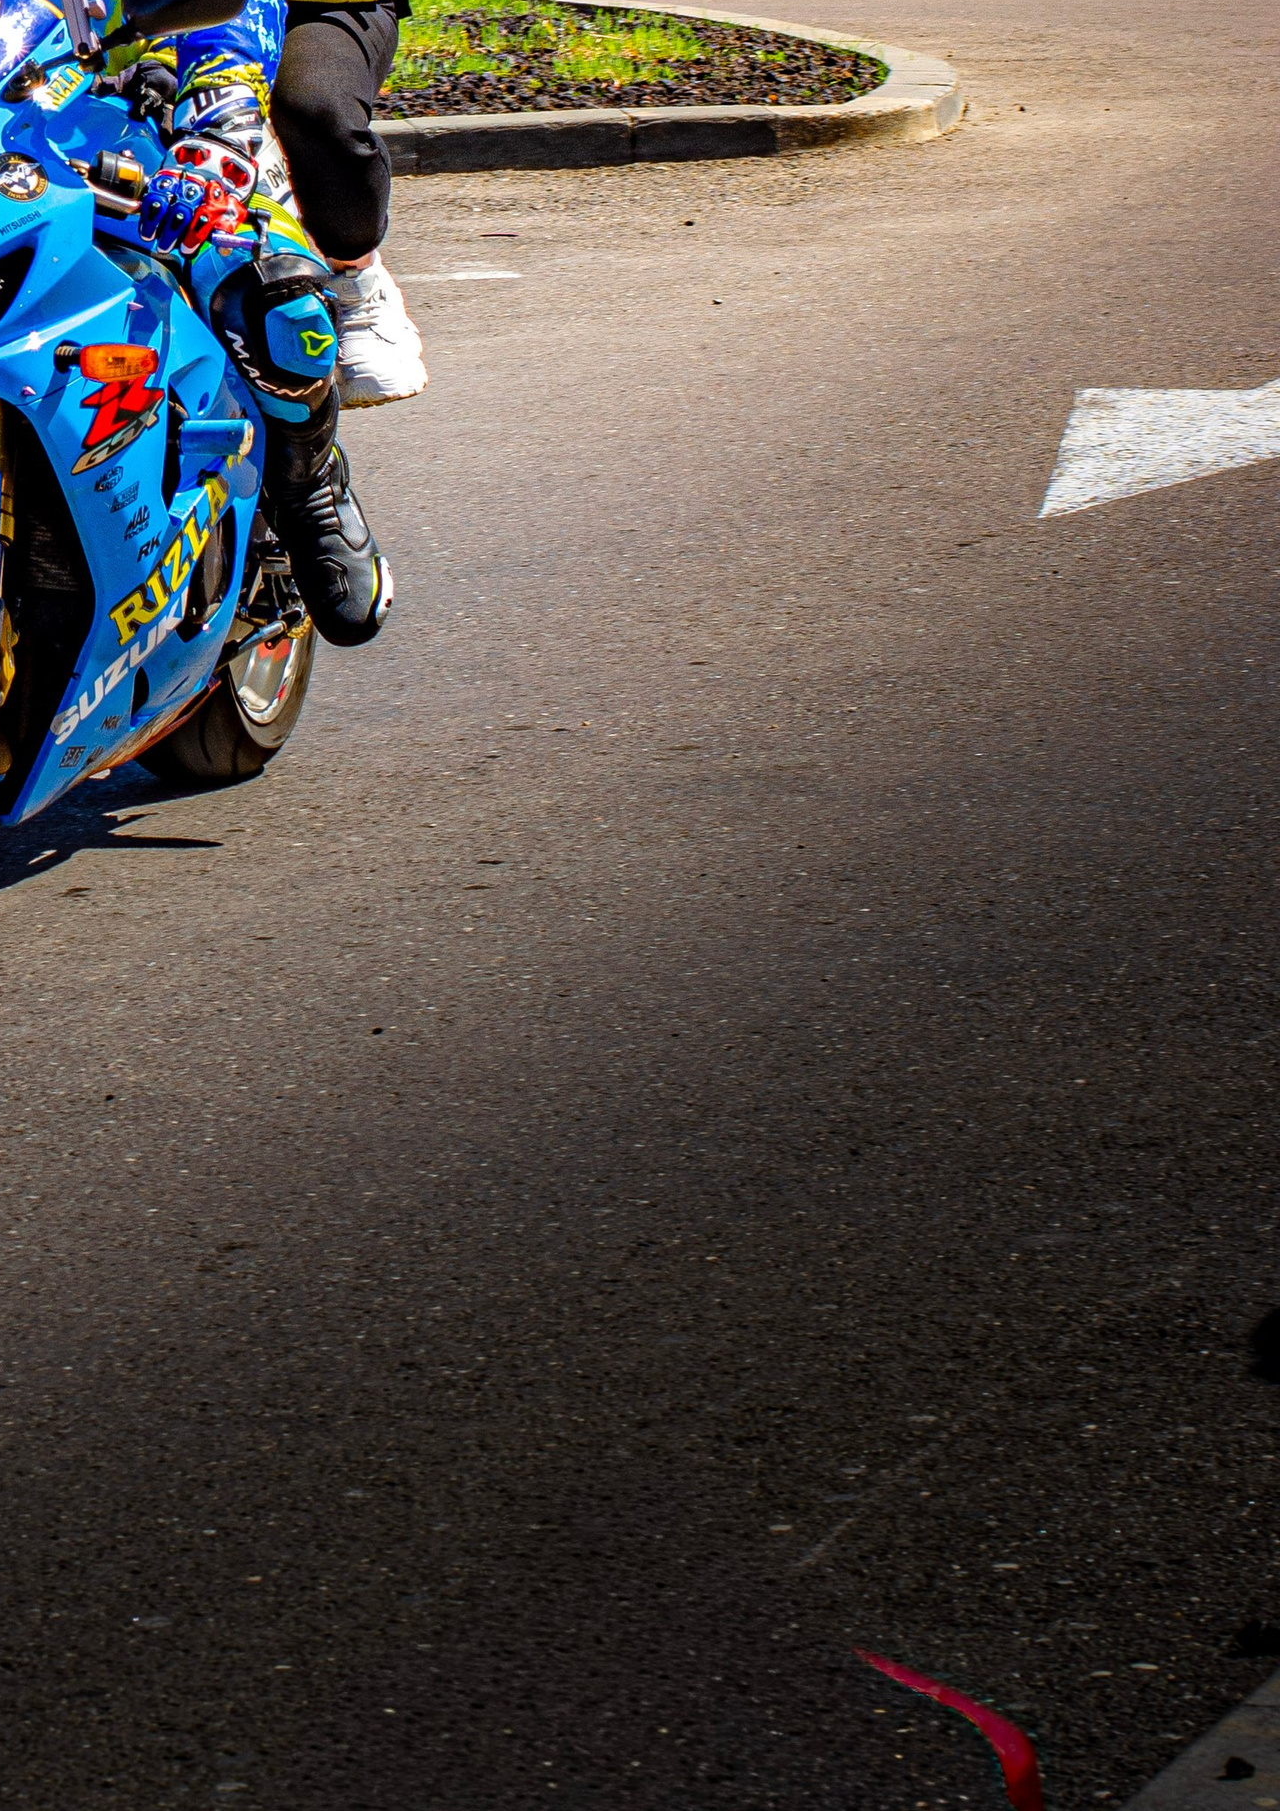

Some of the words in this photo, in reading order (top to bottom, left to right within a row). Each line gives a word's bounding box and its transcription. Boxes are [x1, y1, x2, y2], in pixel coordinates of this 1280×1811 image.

[109, 473, 229, 646] RIZLA
[137, 530, 162, 563] RK
[50, 586, 189, 745] SUZUKI
